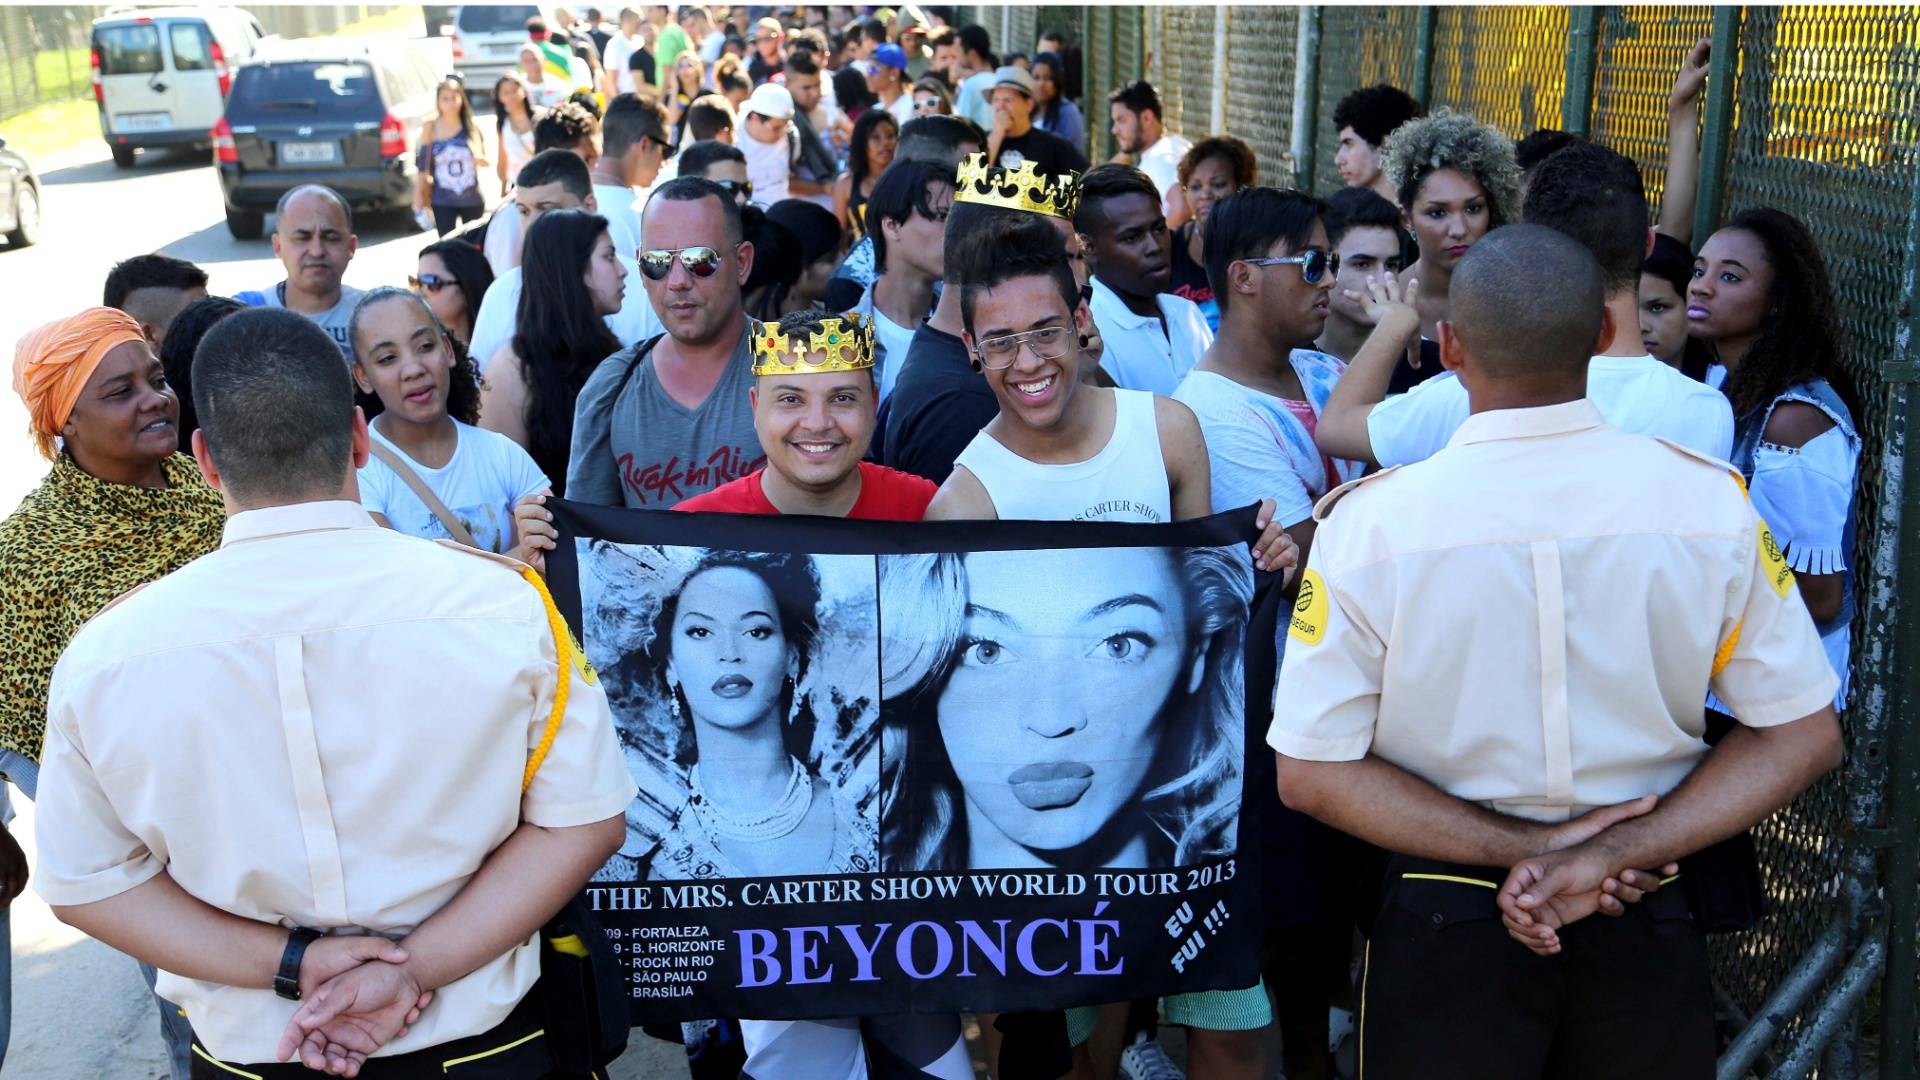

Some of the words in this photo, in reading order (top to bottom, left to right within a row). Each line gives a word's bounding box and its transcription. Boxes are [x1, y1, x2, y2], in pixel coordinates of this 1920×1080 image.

[617, 452, 684, 505] Rock
[685, 461, 710, 487] in
[1084, 499, 1131, 519] CARTER
[1291, 616, 1316, 636] SEGUR
[586, 887, 653, 911] THE
[661, 884, 734, 909] MRS.
[740, 879, 863, 906] CARTER
[871, 875, 964, 901] SHOW
[969, 874, 1087, 898] WORLD
[1094, 872, 1181, 896] TOUR
[1187, 859, 1236, 891] 2013
[1164, 901, 1194, 938] EU
[632, 925, 710, 939] FORTALEZA
[1171, 930, 1206, 974] FUI
[1203, 899, 1230, 935] !!!
[632, 943, 645, 954] B.
[648, 939, 726, 953] HORIZONTE
[732, 901, 1124, 989] BEYONCÉ
[632, 957, 672, 969] ROCK
[674, 956, 689, 967] IN
[691, 955, 715, 967] RIO
[632, 970, 661, 983] SÃO
[664, 971, 708, 983] PAULO
[633, 984, 694, 998] BRASÍLIA
